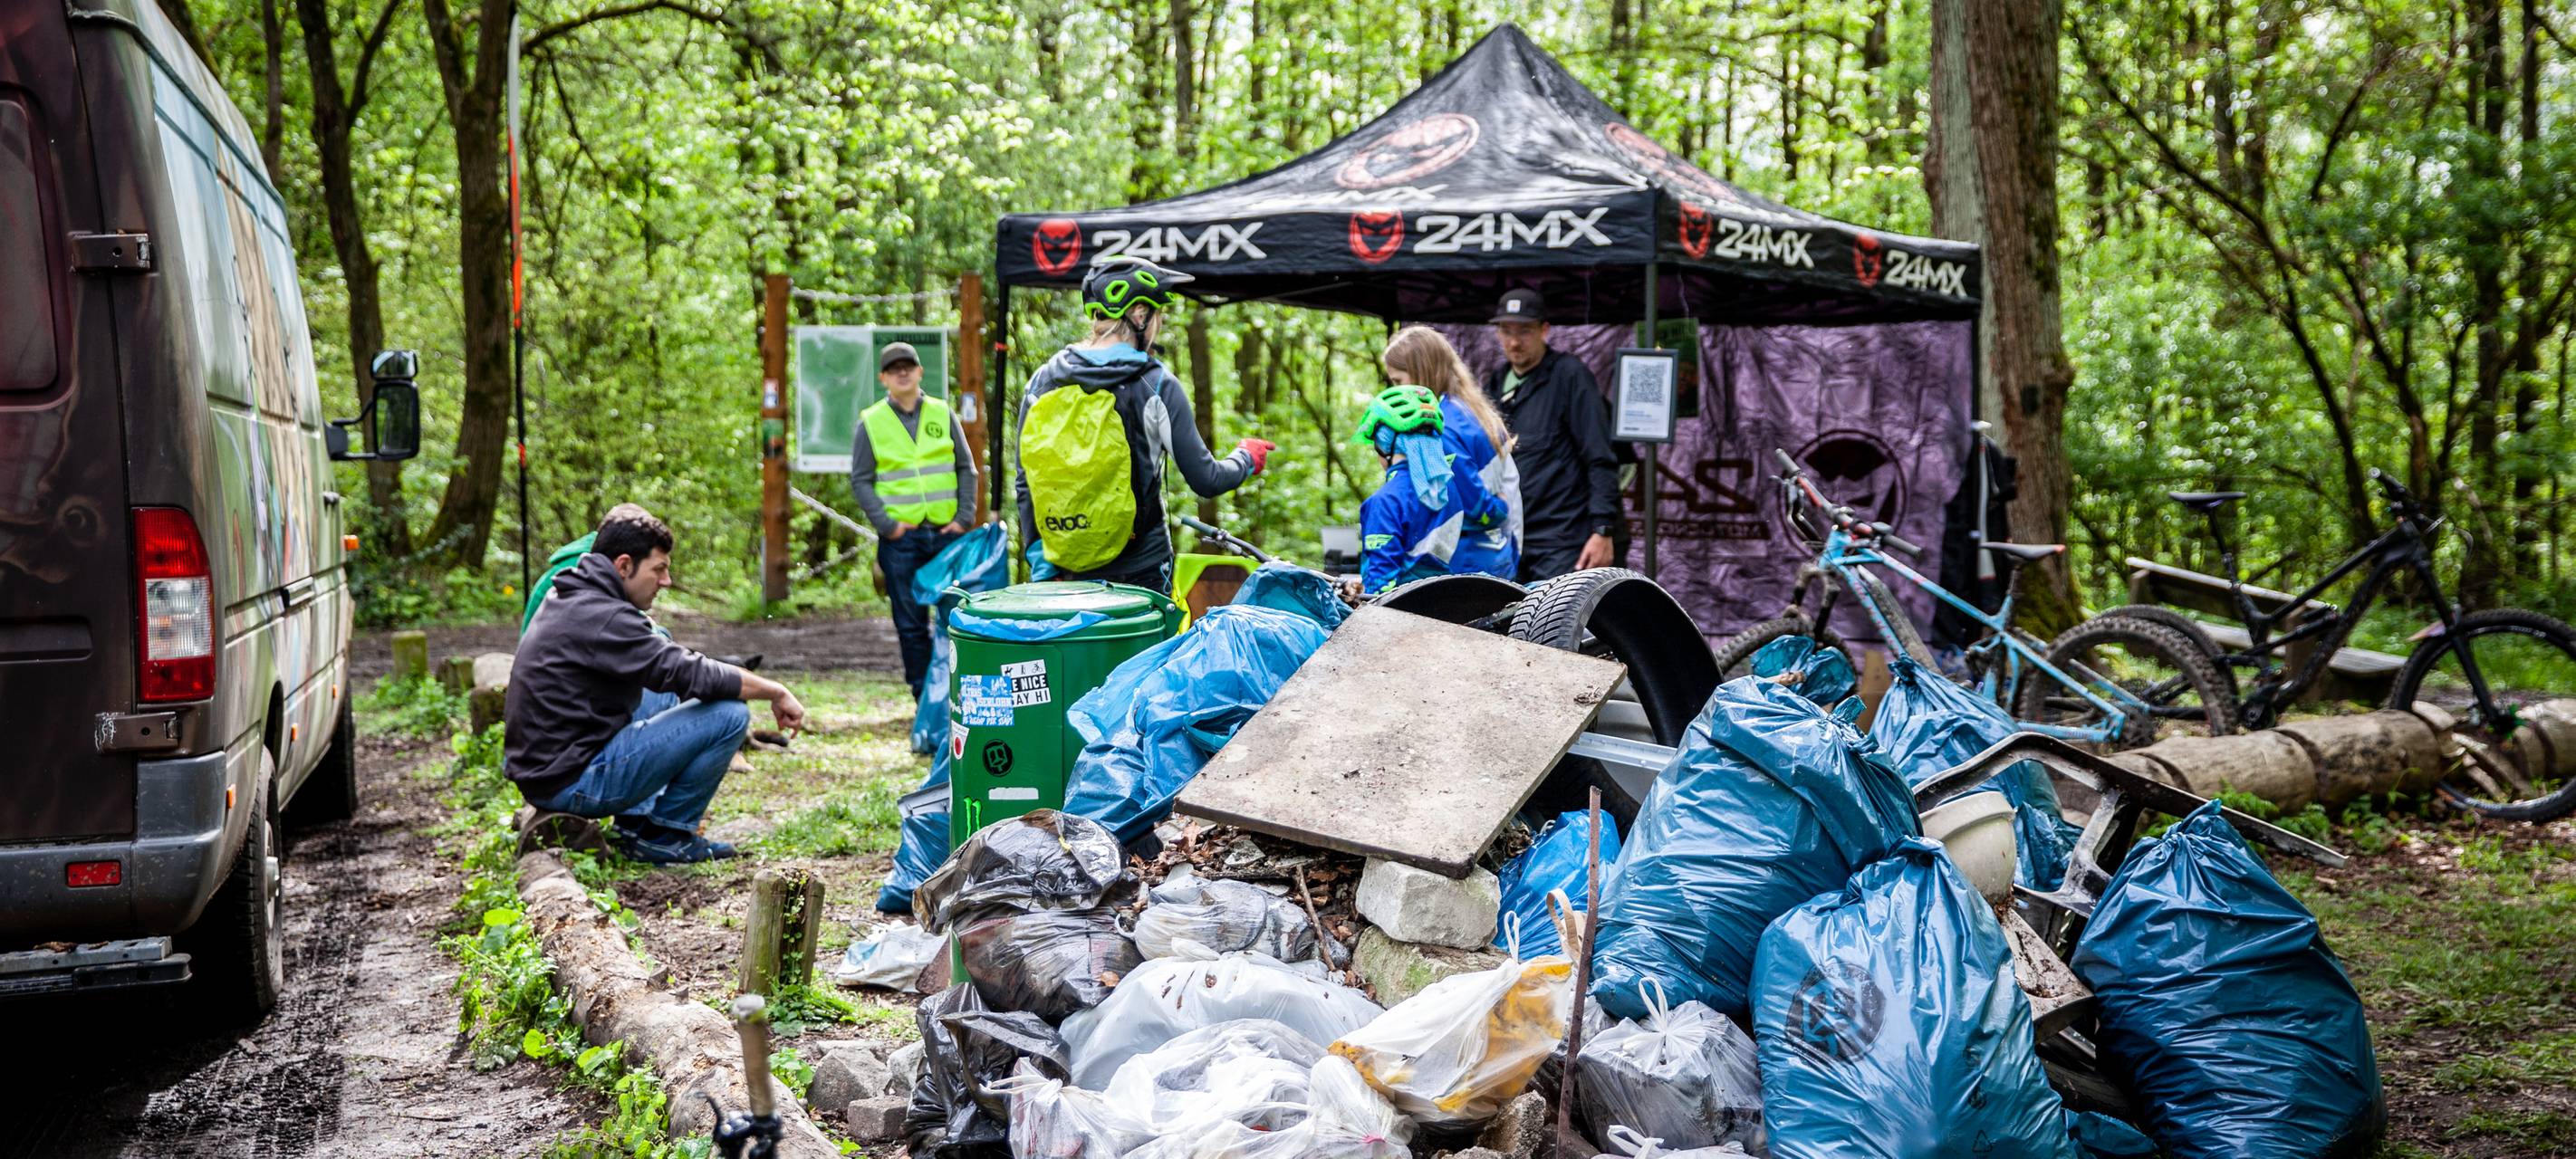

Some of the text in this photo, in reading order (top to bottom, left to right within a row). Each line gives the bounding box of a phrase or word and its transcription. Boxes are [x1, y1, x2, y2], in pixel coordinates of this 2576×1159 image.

[1090, 222, 1268, 270] 24MX
[1412, 207, 1612, 254] 24MX
[1715, 218, 1816, 270] 24MX
[1884, 249, 1968, 299] 24MX
[1021, 675, 1047, 690] NICE
[1035, 690, 1049, 703] HI
